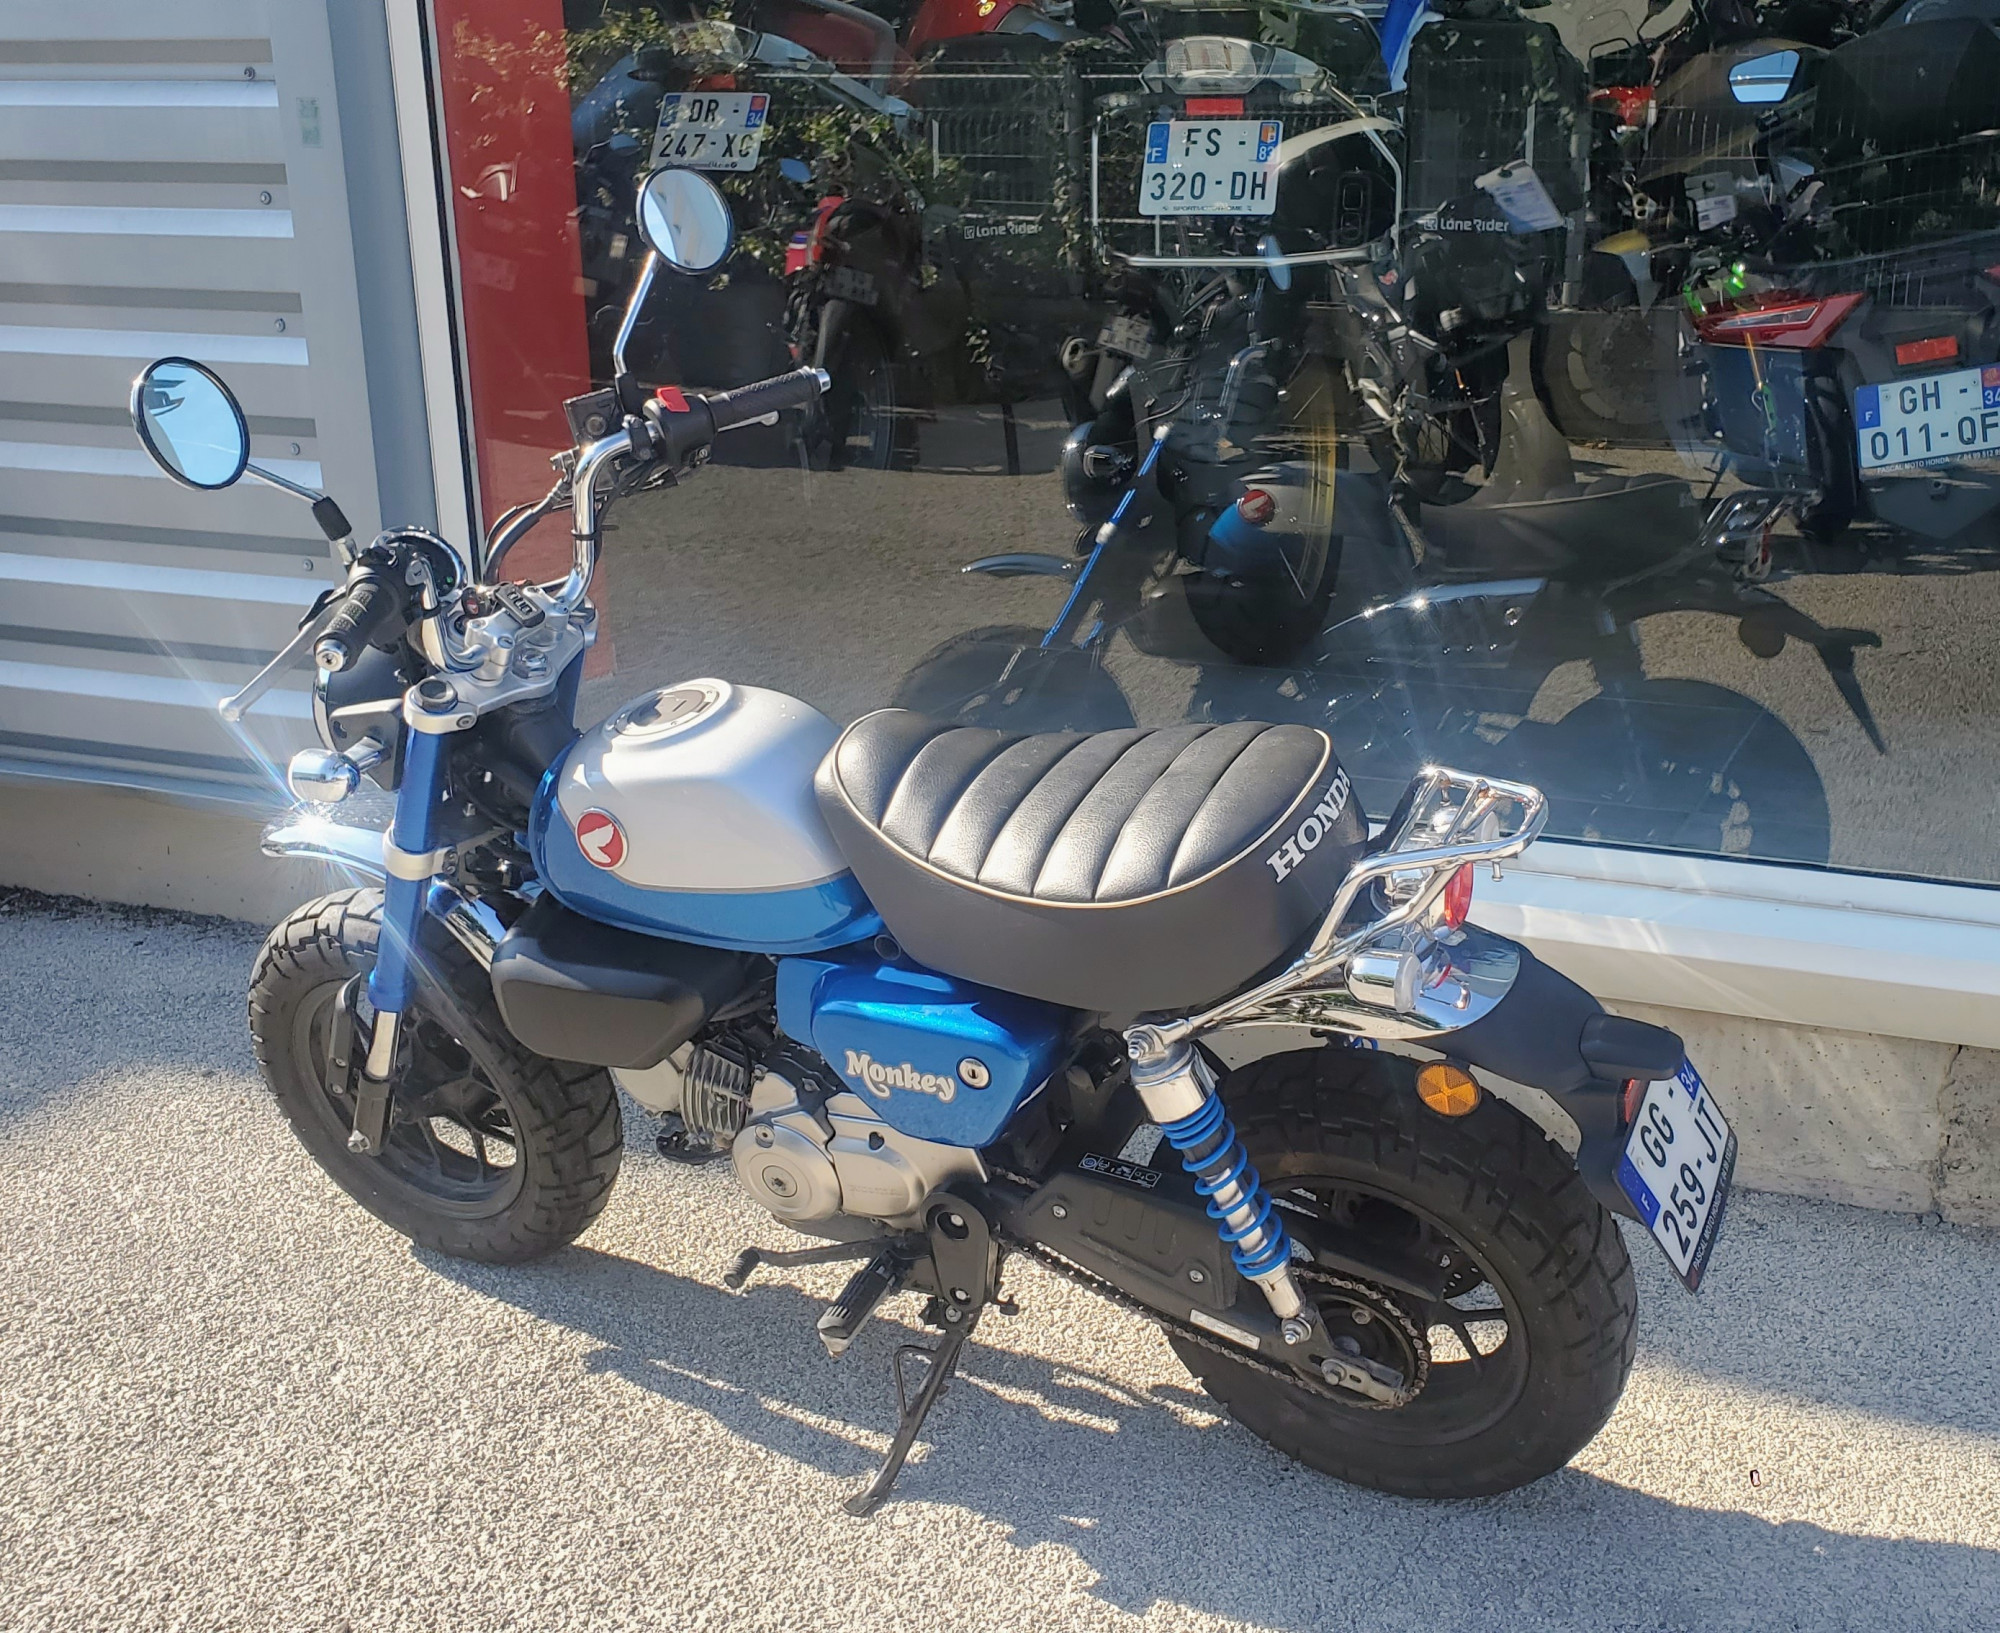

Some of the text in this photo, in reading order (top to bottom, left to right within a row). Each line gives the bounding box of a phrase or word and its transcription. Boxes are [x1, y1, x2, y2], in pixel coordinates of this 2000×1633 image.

[688, 99, 720, 122] DR
[746, 112, 763, 126] 34
[1150, 147, 1163, 162] F
[1185, 128, 1222, 157] FS
[1150, 171, 1268, 201] 320-DH
[1473, 218, 1510, 232] Rider
[1898, 380, 1941, 415] GH
[1865, 410, 1873, 422] F
[1877, 463, 1903, 474] PASCAL
[1904, 460, 1924, 470] MOTO
[1925, 456, 1950, 467] HONDA
[1266, 766, 1351, 884] HONDA
[844, 1048, 957, 1103] Monkey
[1681, 1063, 1696, 1092] 34
[1640, 1102, 1675, 1168] GG
[1662, 1096, 1722, 1259] 259-JT
[1641, 1192, 1650, 1211] F
[1692, 1239, 1708, 1271] PASCAL
[1703, 1215, 1715, 1240] MOTO
